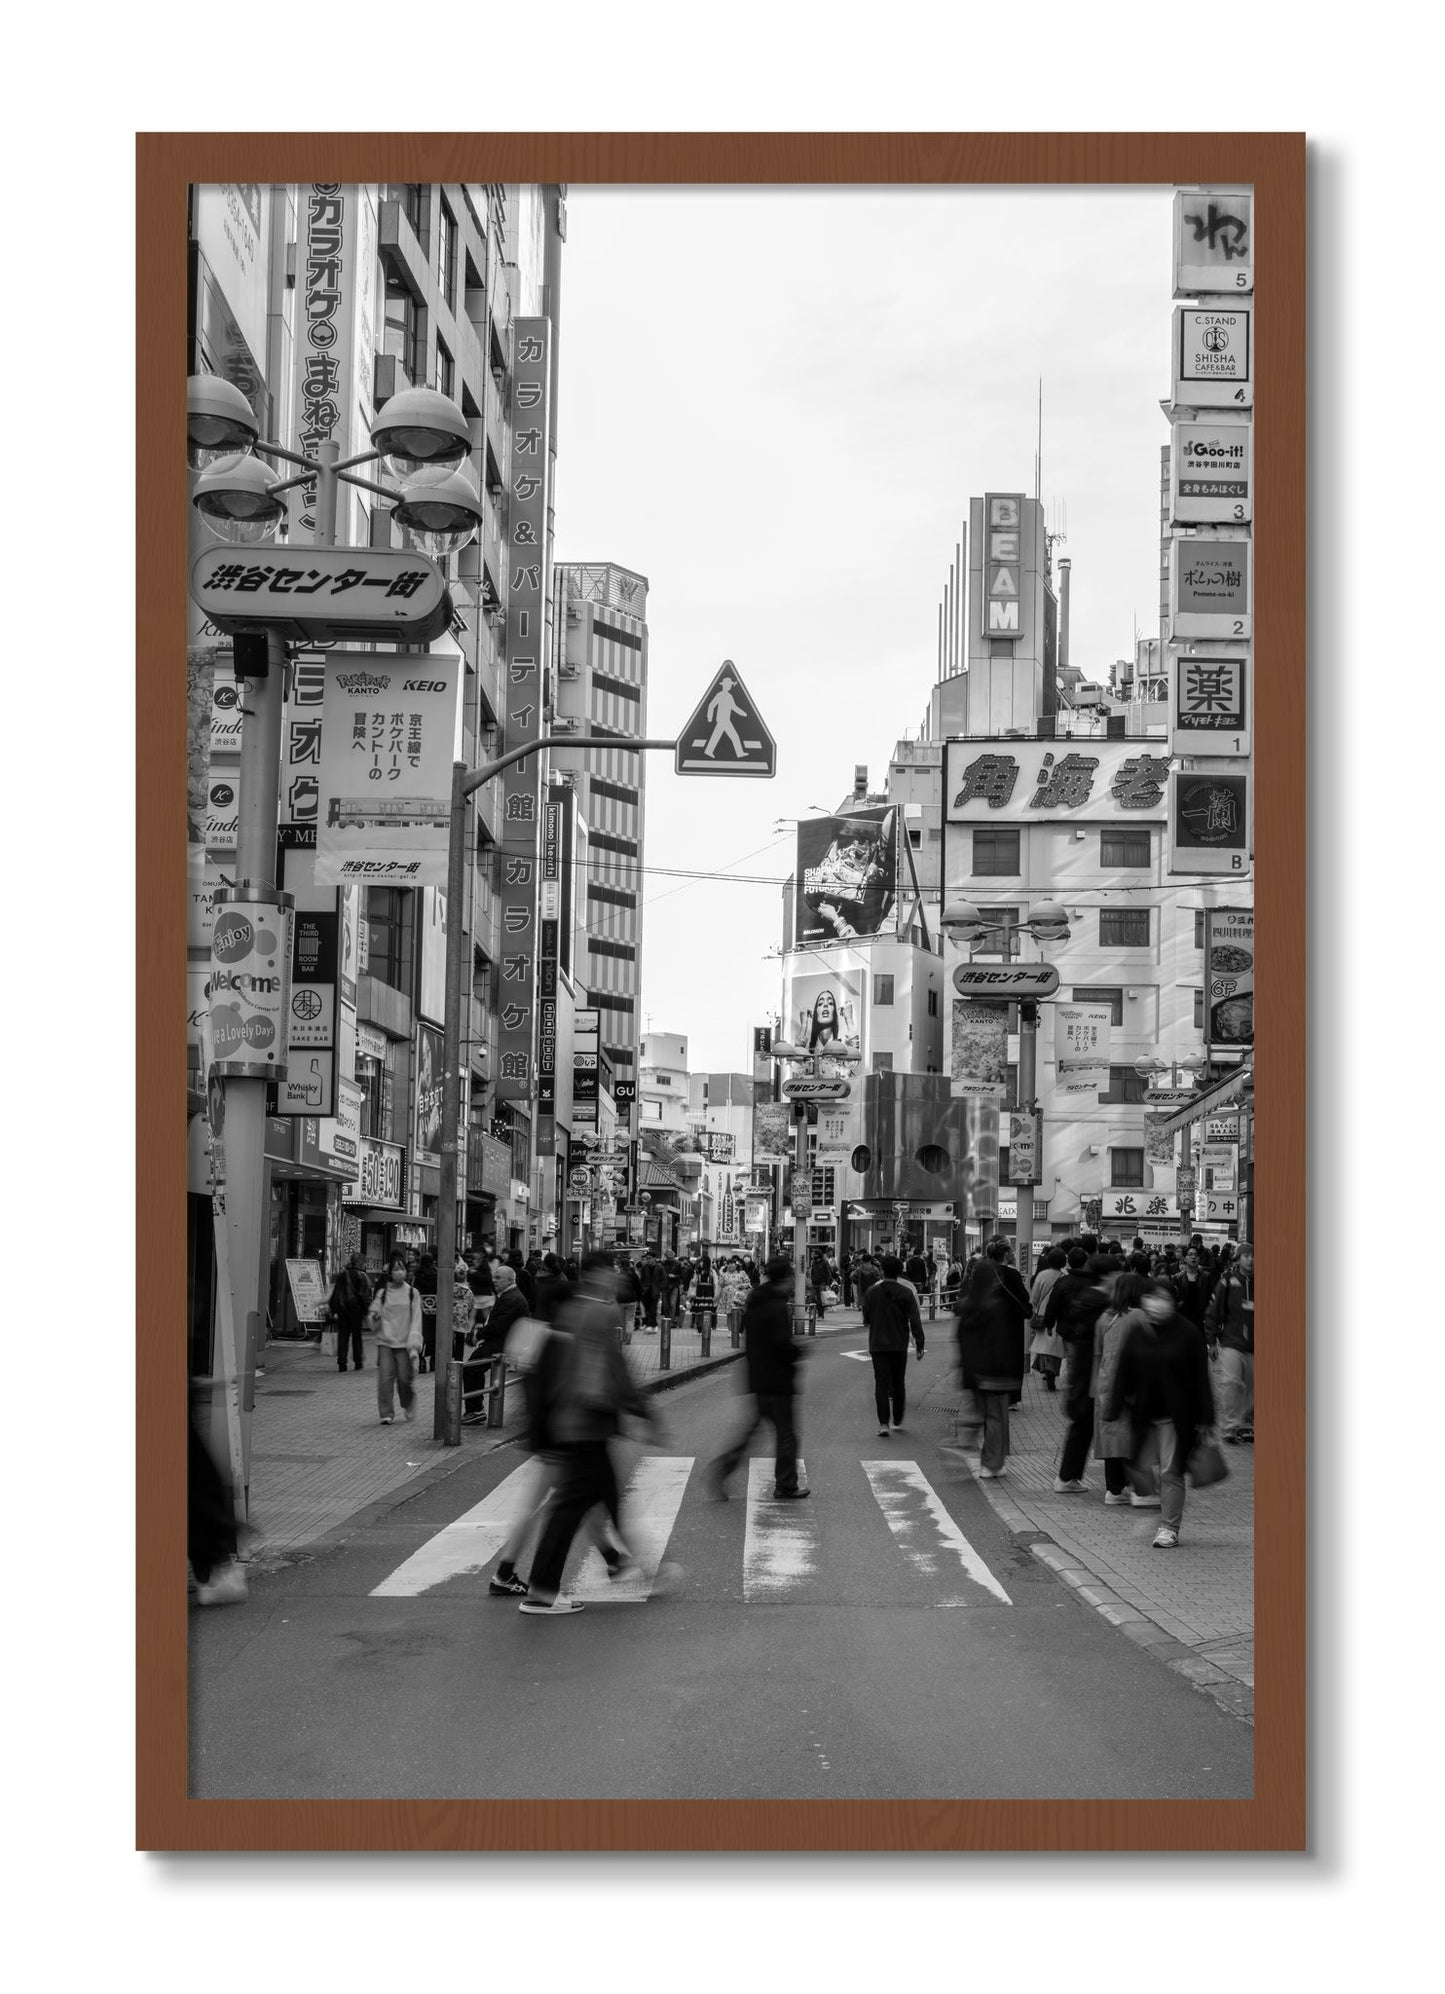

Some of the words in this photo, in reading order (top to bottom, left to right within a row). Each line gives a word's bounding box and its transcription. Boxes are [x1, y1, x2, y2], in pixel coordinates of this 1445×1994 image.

[307, 196, 344, 321] カラオケ
[1236, 273, 1246, 287] 5
[1195, 317, 1236, 325] C.STAND
[1195, 354, 1236, 363] SHISHA
[1194, 443, 1243, 457] Goo-it!
[1187, 461, 1240, 469] 渋谷宇田川町店
[1183, 483, 1245, 494] 全身もみほぐし
[1234, 505, 1244, 519] 3
[989, 498, 1018, 630] BEAM
[202, 564, 430, 598] 渋谷センター街
[1233, 621, 1243, 634] 2
[402, 680, 447, 692] KEIO
[1187, 665, 1232, 711] 薬
[1181, 714, 1238, 727] マツモトキヨシ
[352, 712, 367, 752] 冒険へ
[369, 713, 385, 780] カントーの
[407, 713, 423, 768] 京王線で
[1233, 738, 1240, 751] 1
[953, 753, 1172, 808] 角海老
[1182, 788, 1237, 832] 一蘭
[547, 807, 556, 840] kimono
[340, 861, 421, 873] 渋谷センター街
[547, 844, 556, 876] hearts
[1232, 855, 1242, 869] B
[215, 924, 251, 955] Enjoy
[500, 859, 533, 1080] カラオケ館
[211, 970, 280, 993] Welcome
[960, 971, 1053, 983] 渋谷センター街
[1211, 980, 1237, 997] 6F
[227, 1023, 254, 1041] Lovely
[256, 1024, 273, 1037] Day!
[288, 1083, 318, 1093] Whisky
[616, 1087, 634, 1096] GU
[786, 1084, 842, 1092] 渋谷センター街
[287, 1092, 306, 1100] Bank
[1115, 1195, 1169, 1215] 兆楽
